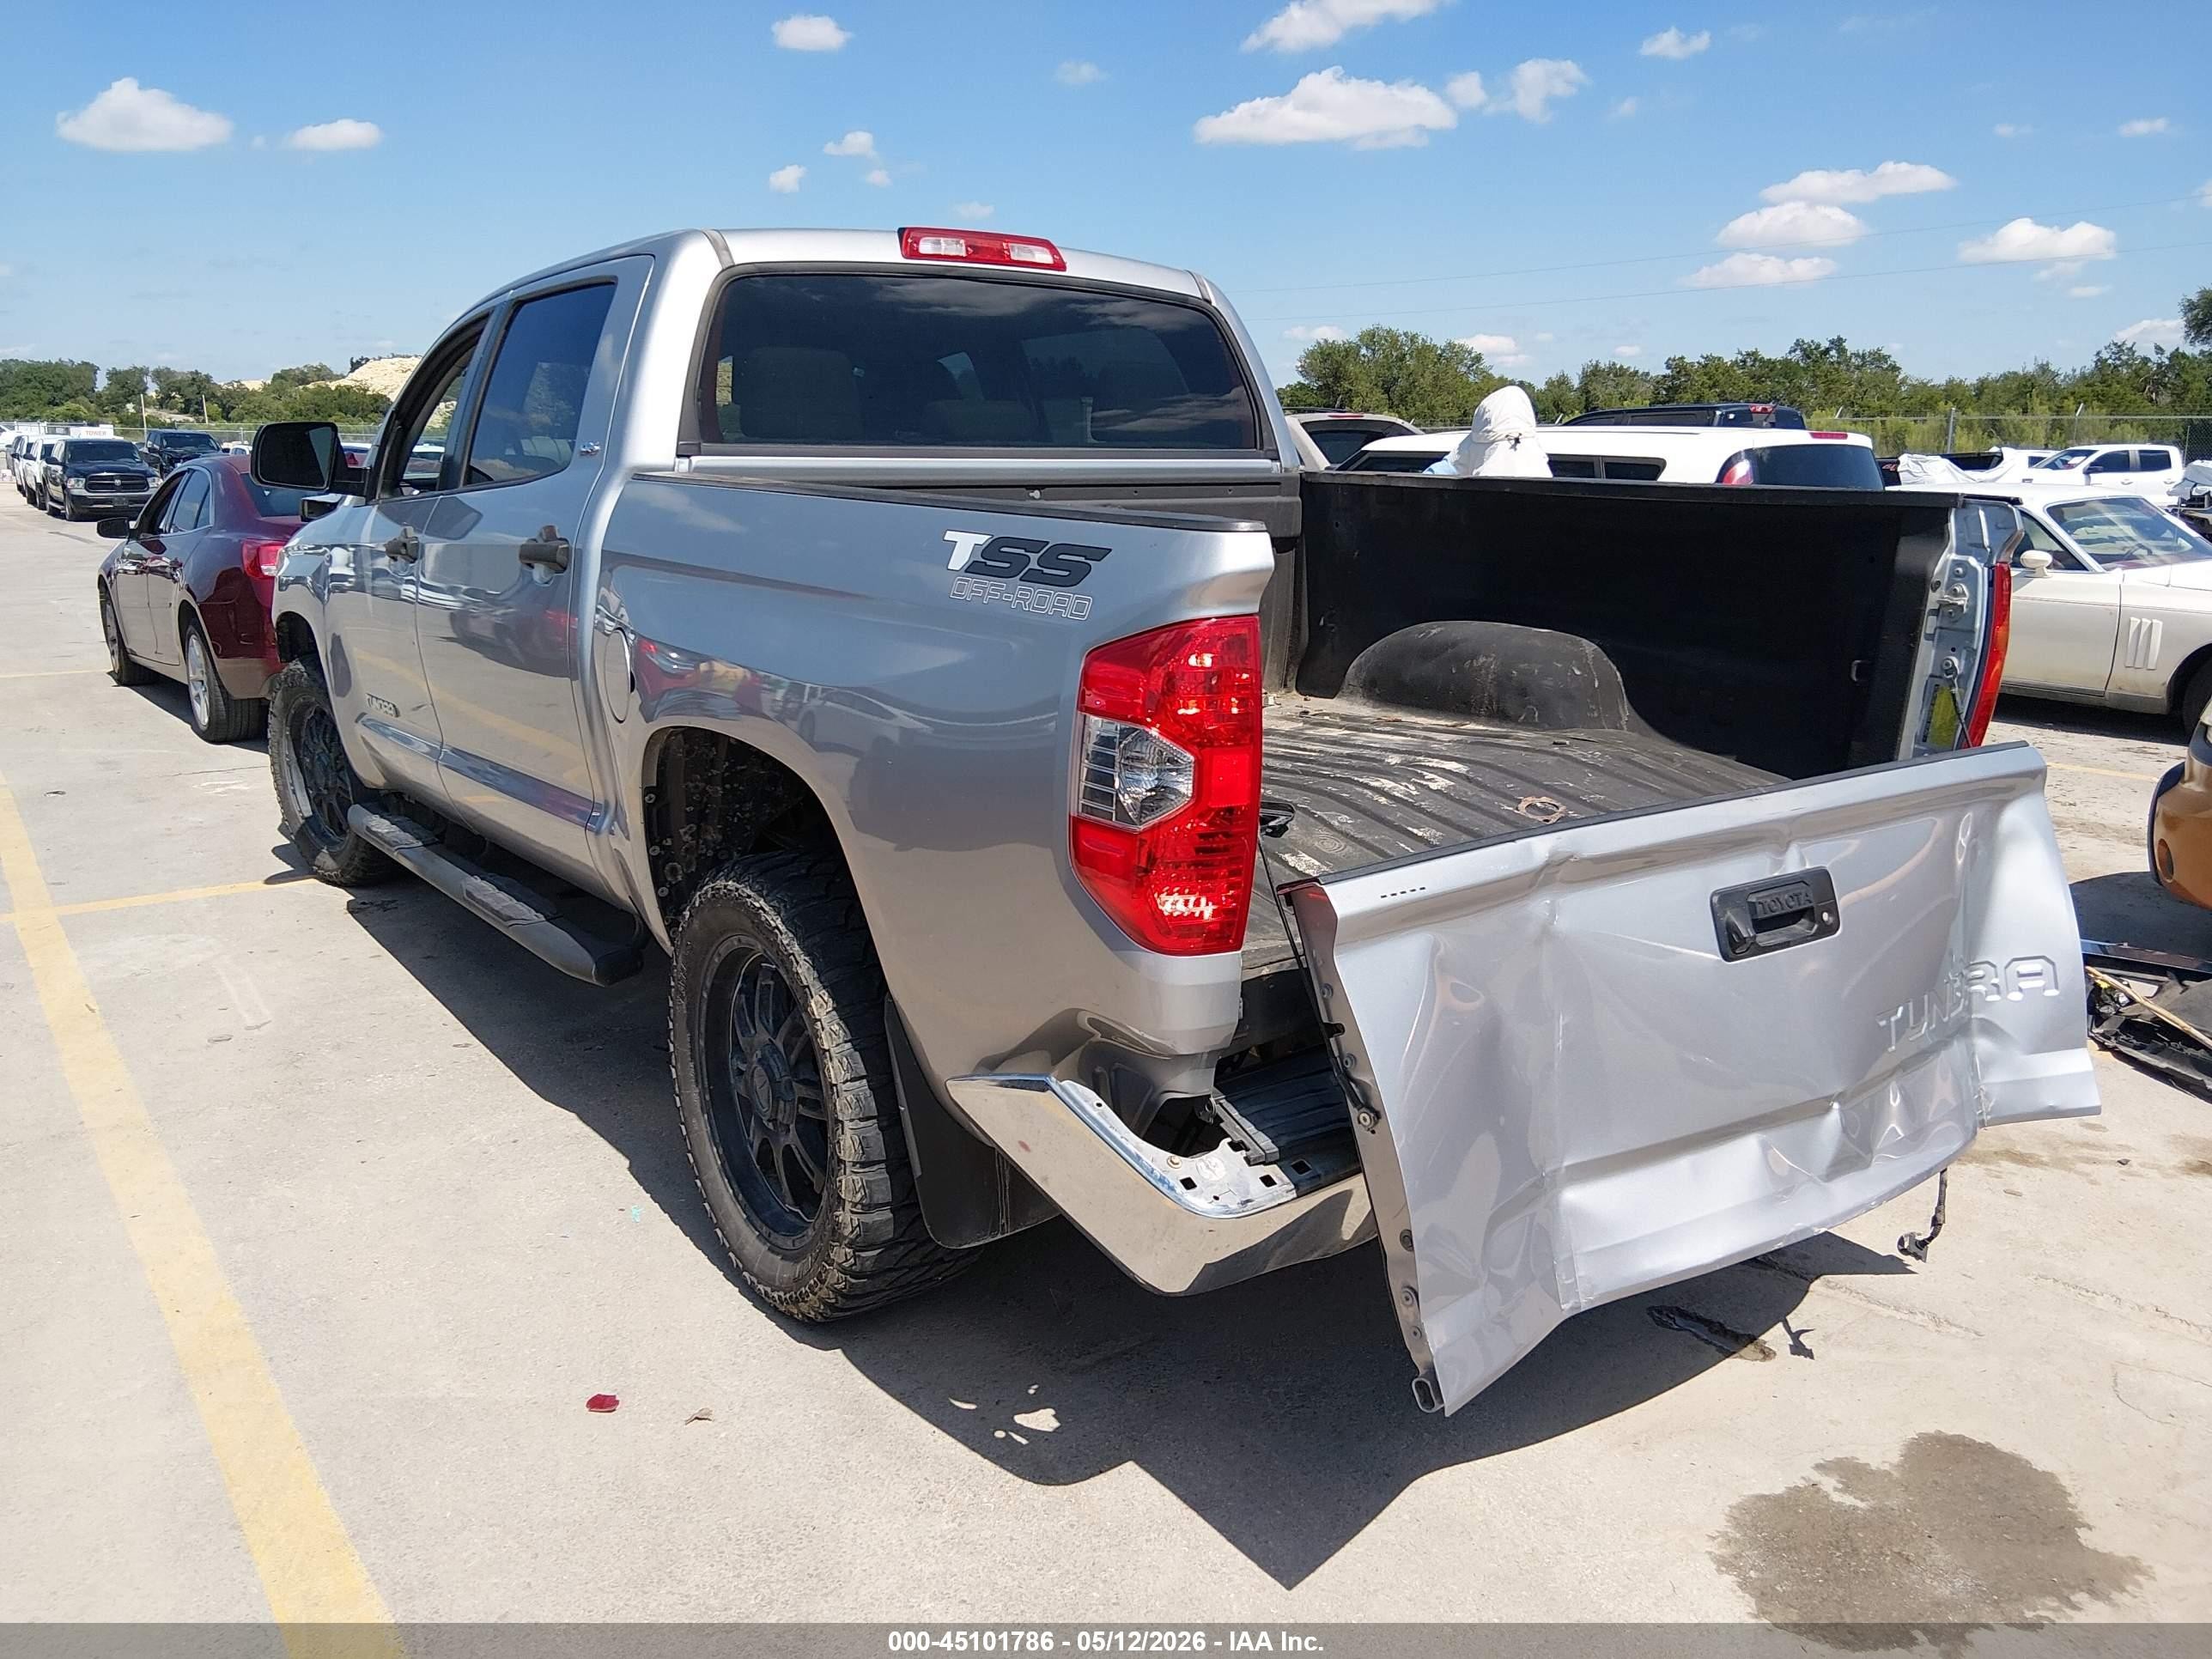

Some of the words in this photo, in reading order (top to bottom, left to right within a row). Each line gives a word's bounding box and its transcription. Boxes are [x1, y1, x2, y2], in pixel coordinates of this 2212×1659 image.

[943, 529, 1112, 587] TSS
[949, 576, 1093, 621] OFF-ROAD
[1757, 891, 1813, 915] TOYOTA
